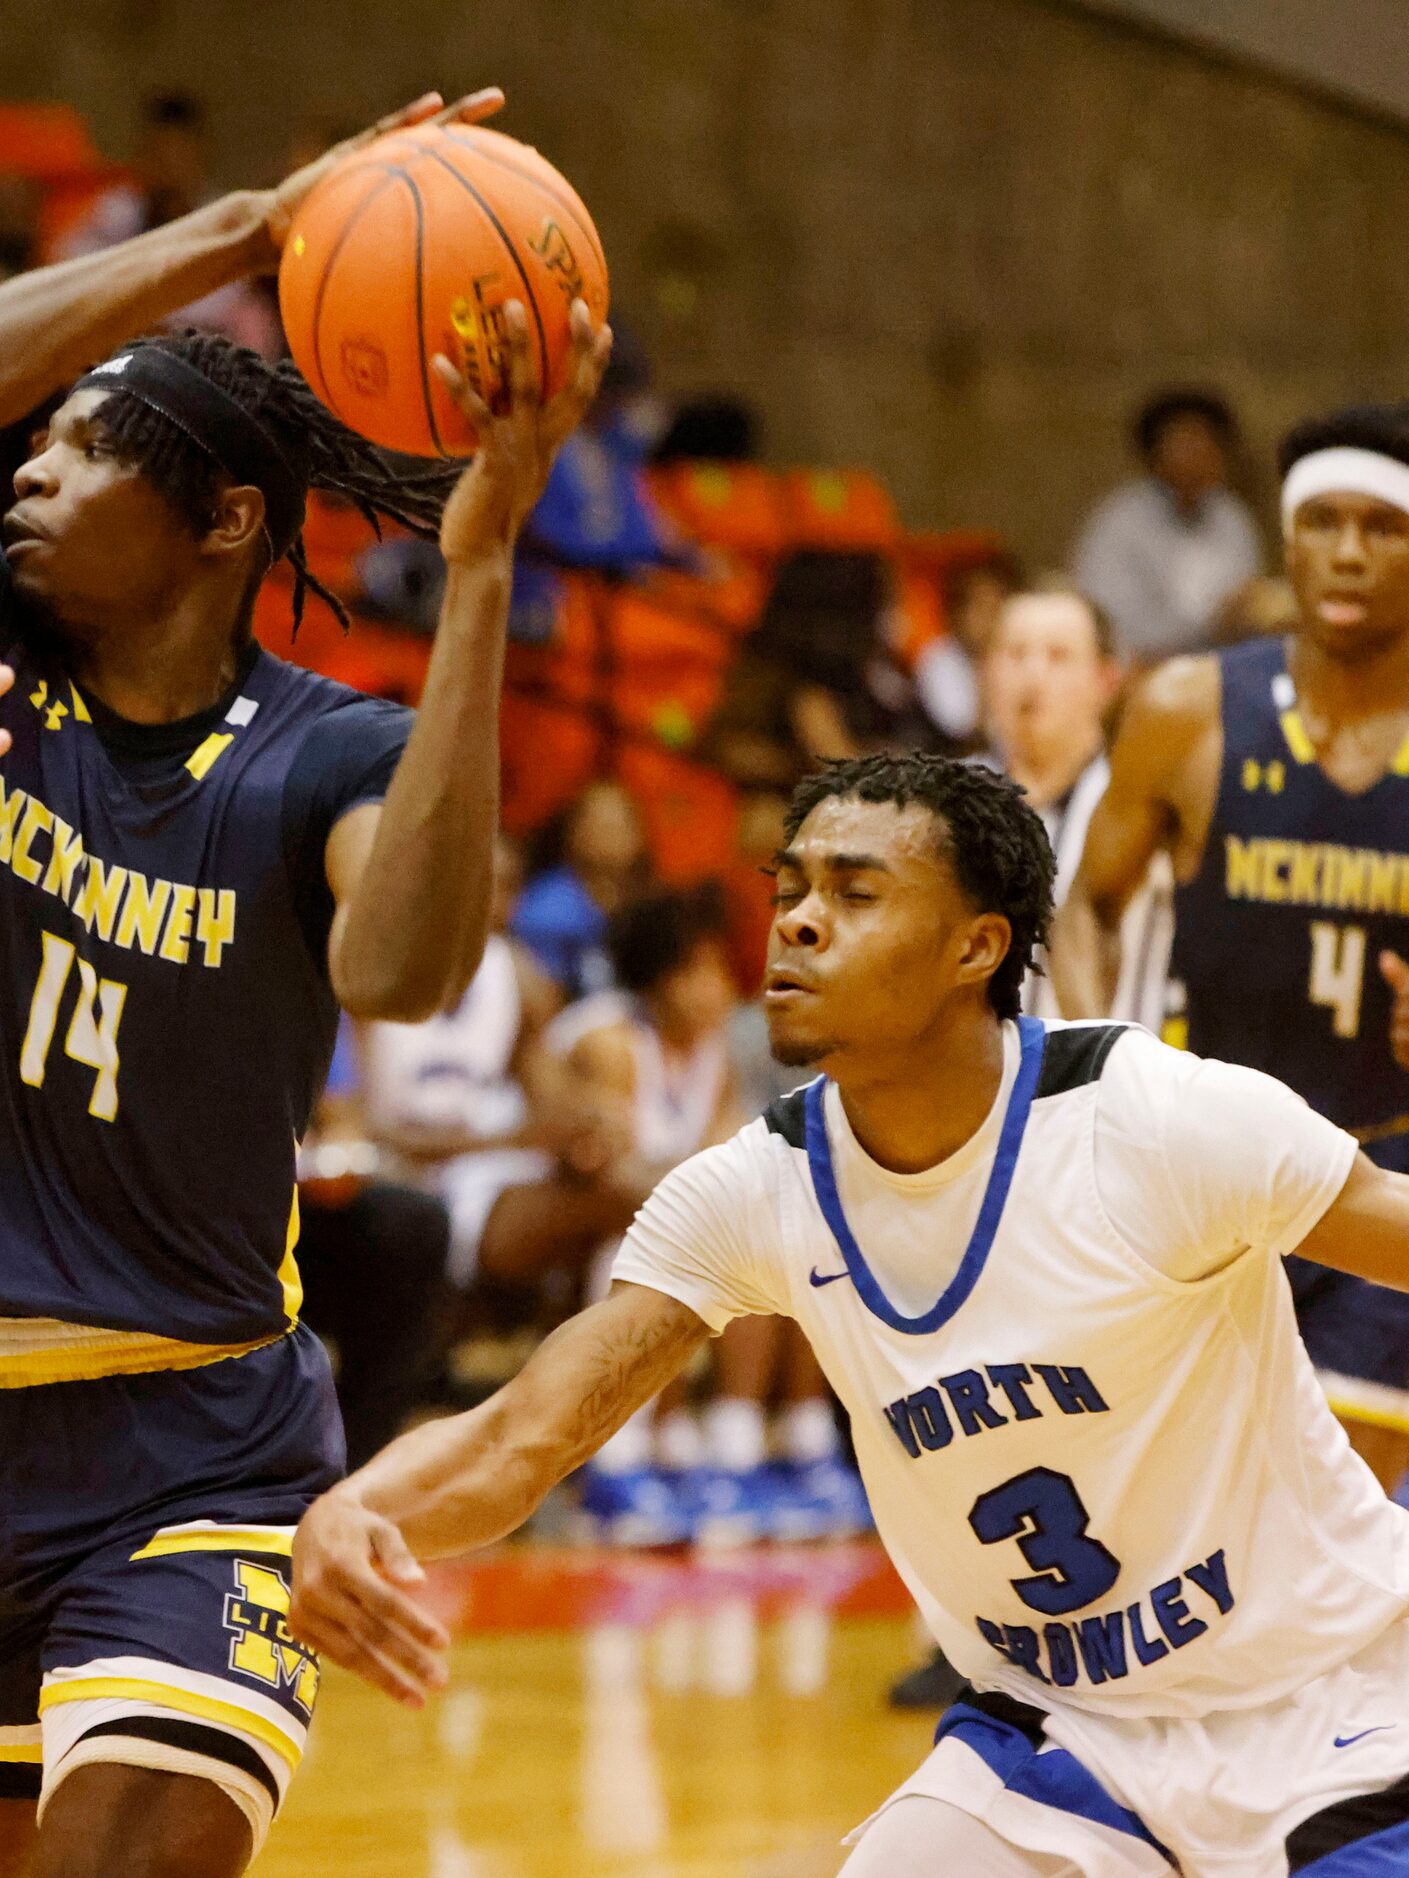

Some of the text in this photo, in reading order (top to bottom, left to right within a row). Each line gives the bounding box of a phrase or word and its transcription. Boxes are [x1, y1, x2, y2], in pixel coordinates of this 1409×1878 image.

[20, 930, 128, 1122] 14
[1309, 920, 1367, 1038] 4
[883, 1363, 1110, 1458] NORTH
[967, 1465, 1121, 1616] 3
